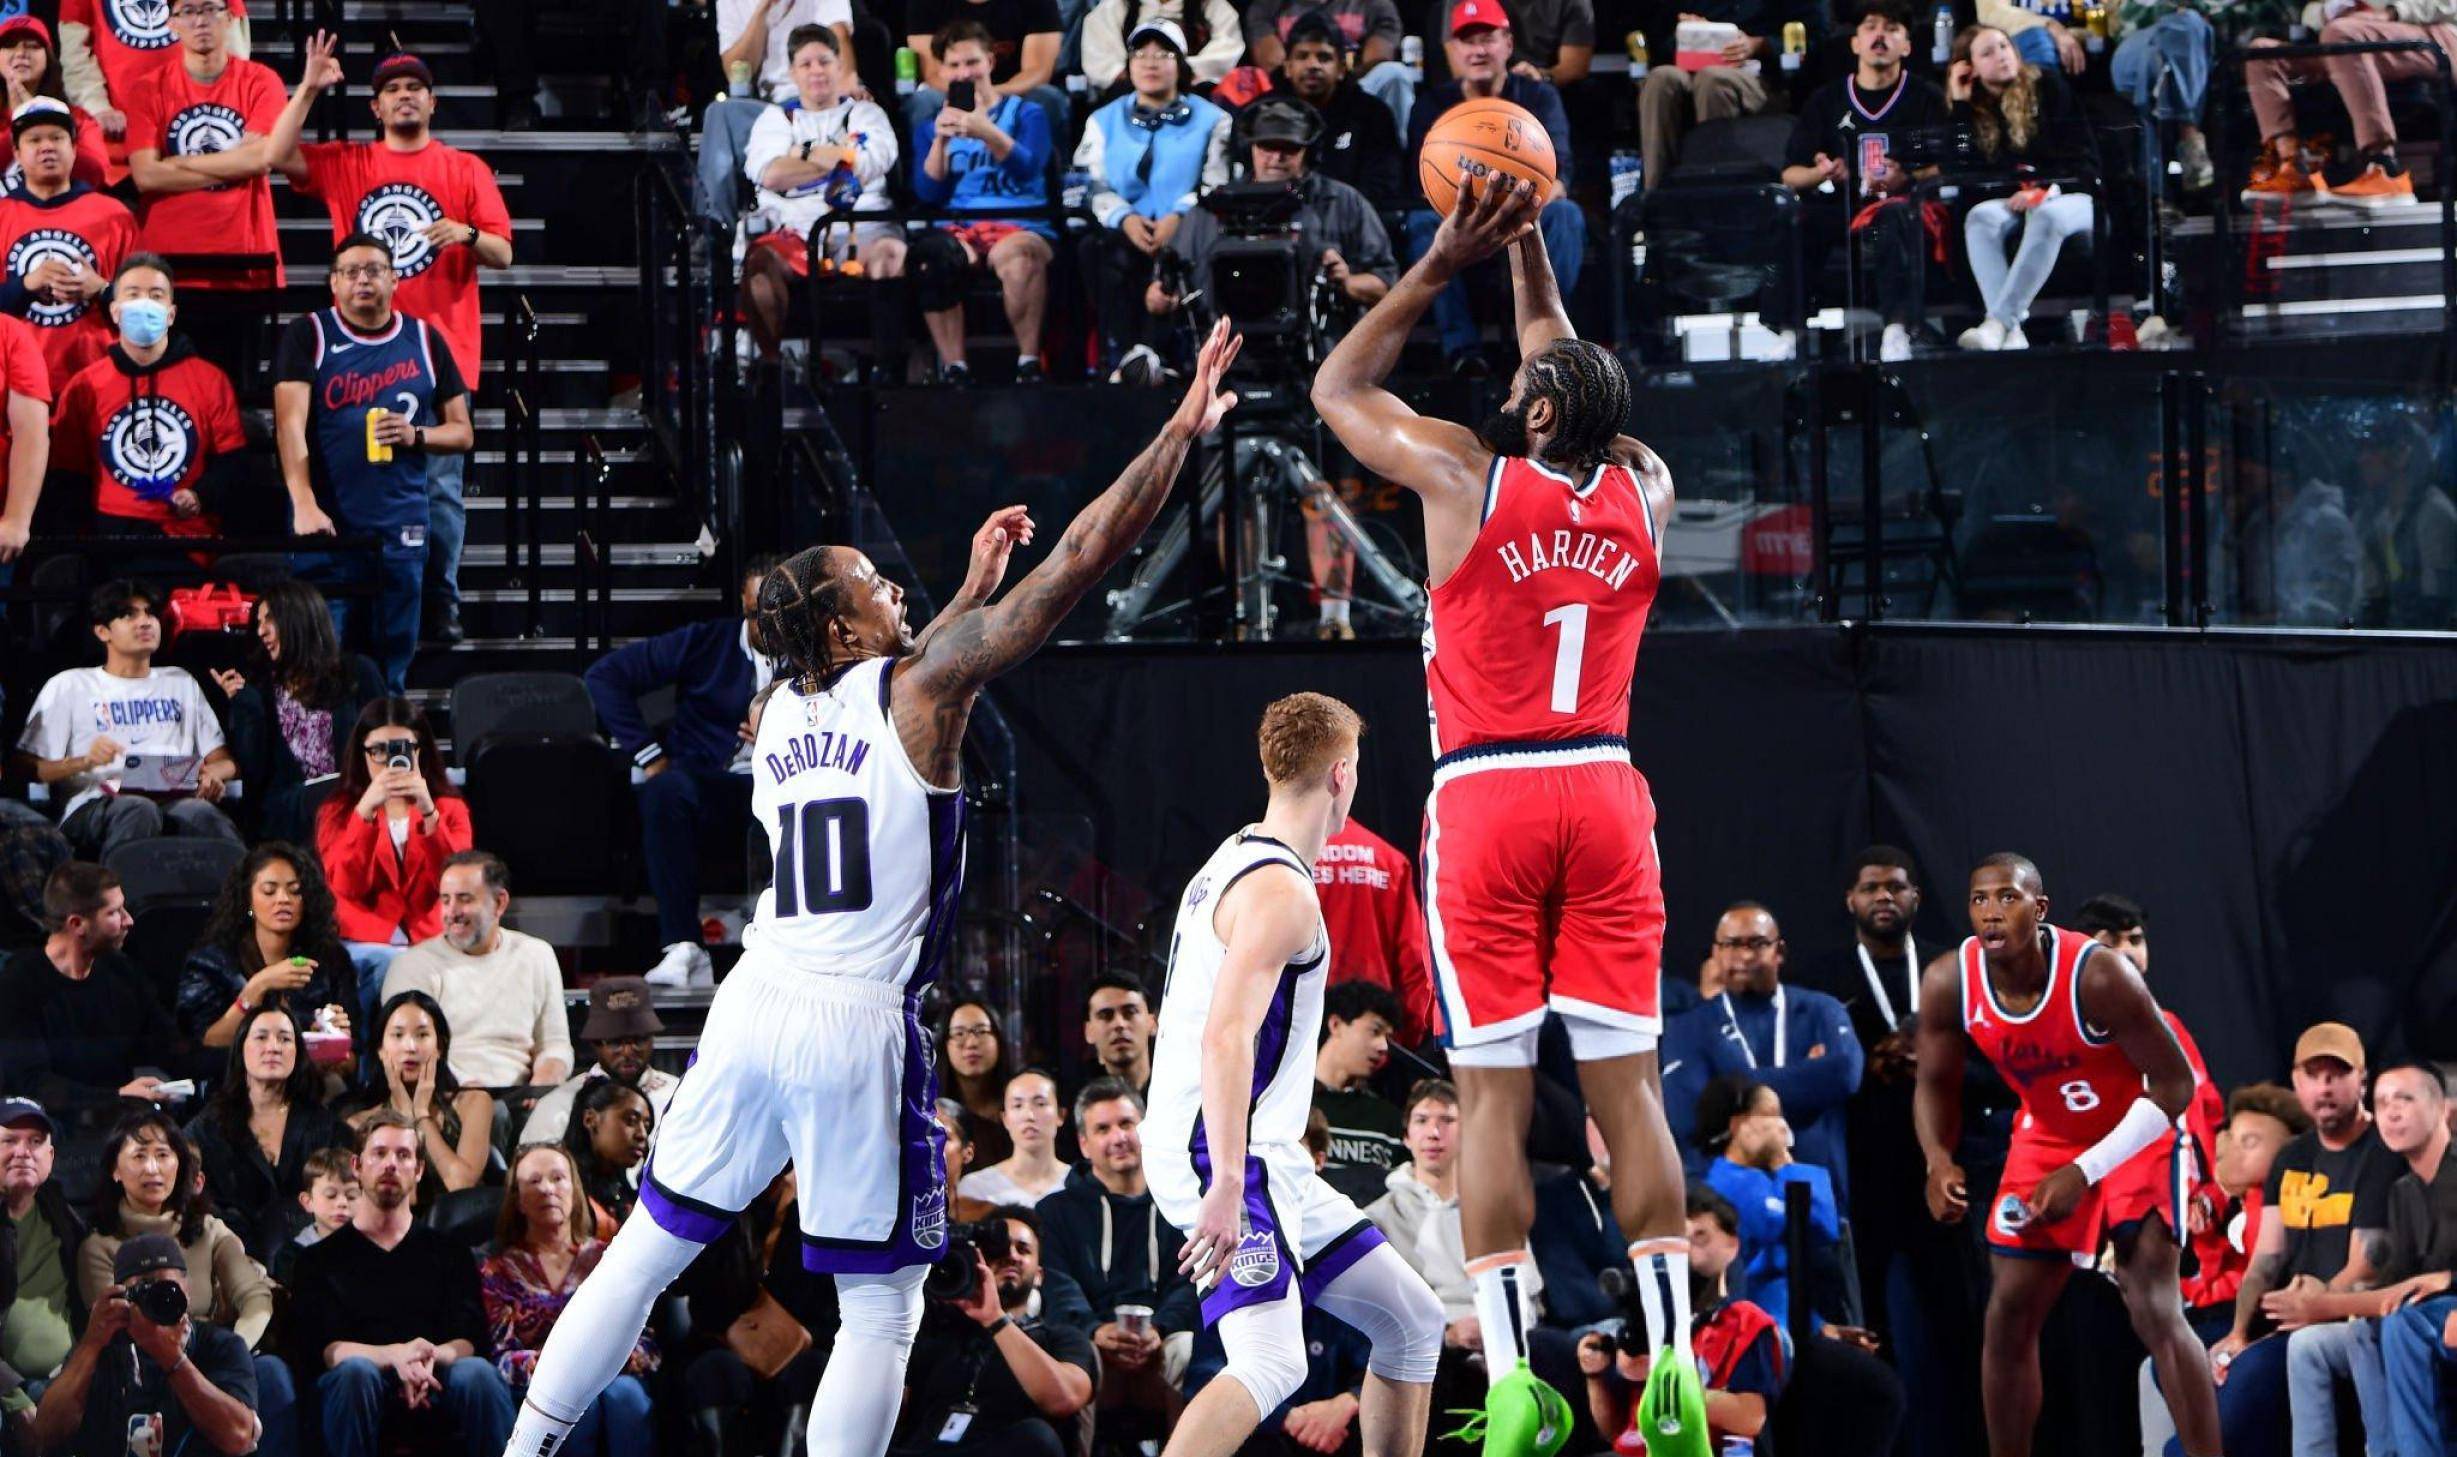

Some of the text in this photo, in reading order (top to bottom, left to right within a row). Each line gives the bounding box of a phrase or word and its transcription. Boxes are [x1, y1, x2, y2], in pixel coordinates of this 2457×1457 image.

[381, 184, 442, 220] ANGELES
[29, 229, 95, 263] ANGELES
[324, 357, 421, 411] Clippers
[1497, 529, 1640, 592] HARDEN
[1543, 602, 1589, 714] 1
[110, 698, 182, 726] CLIPPERS
[775, 796, 873, 918] 10
[1338, 865, 1391, 890] HERE
[2060, 1080, 2100, 1113] 8
[1231, 1252, 1277, 1268] KINGS
